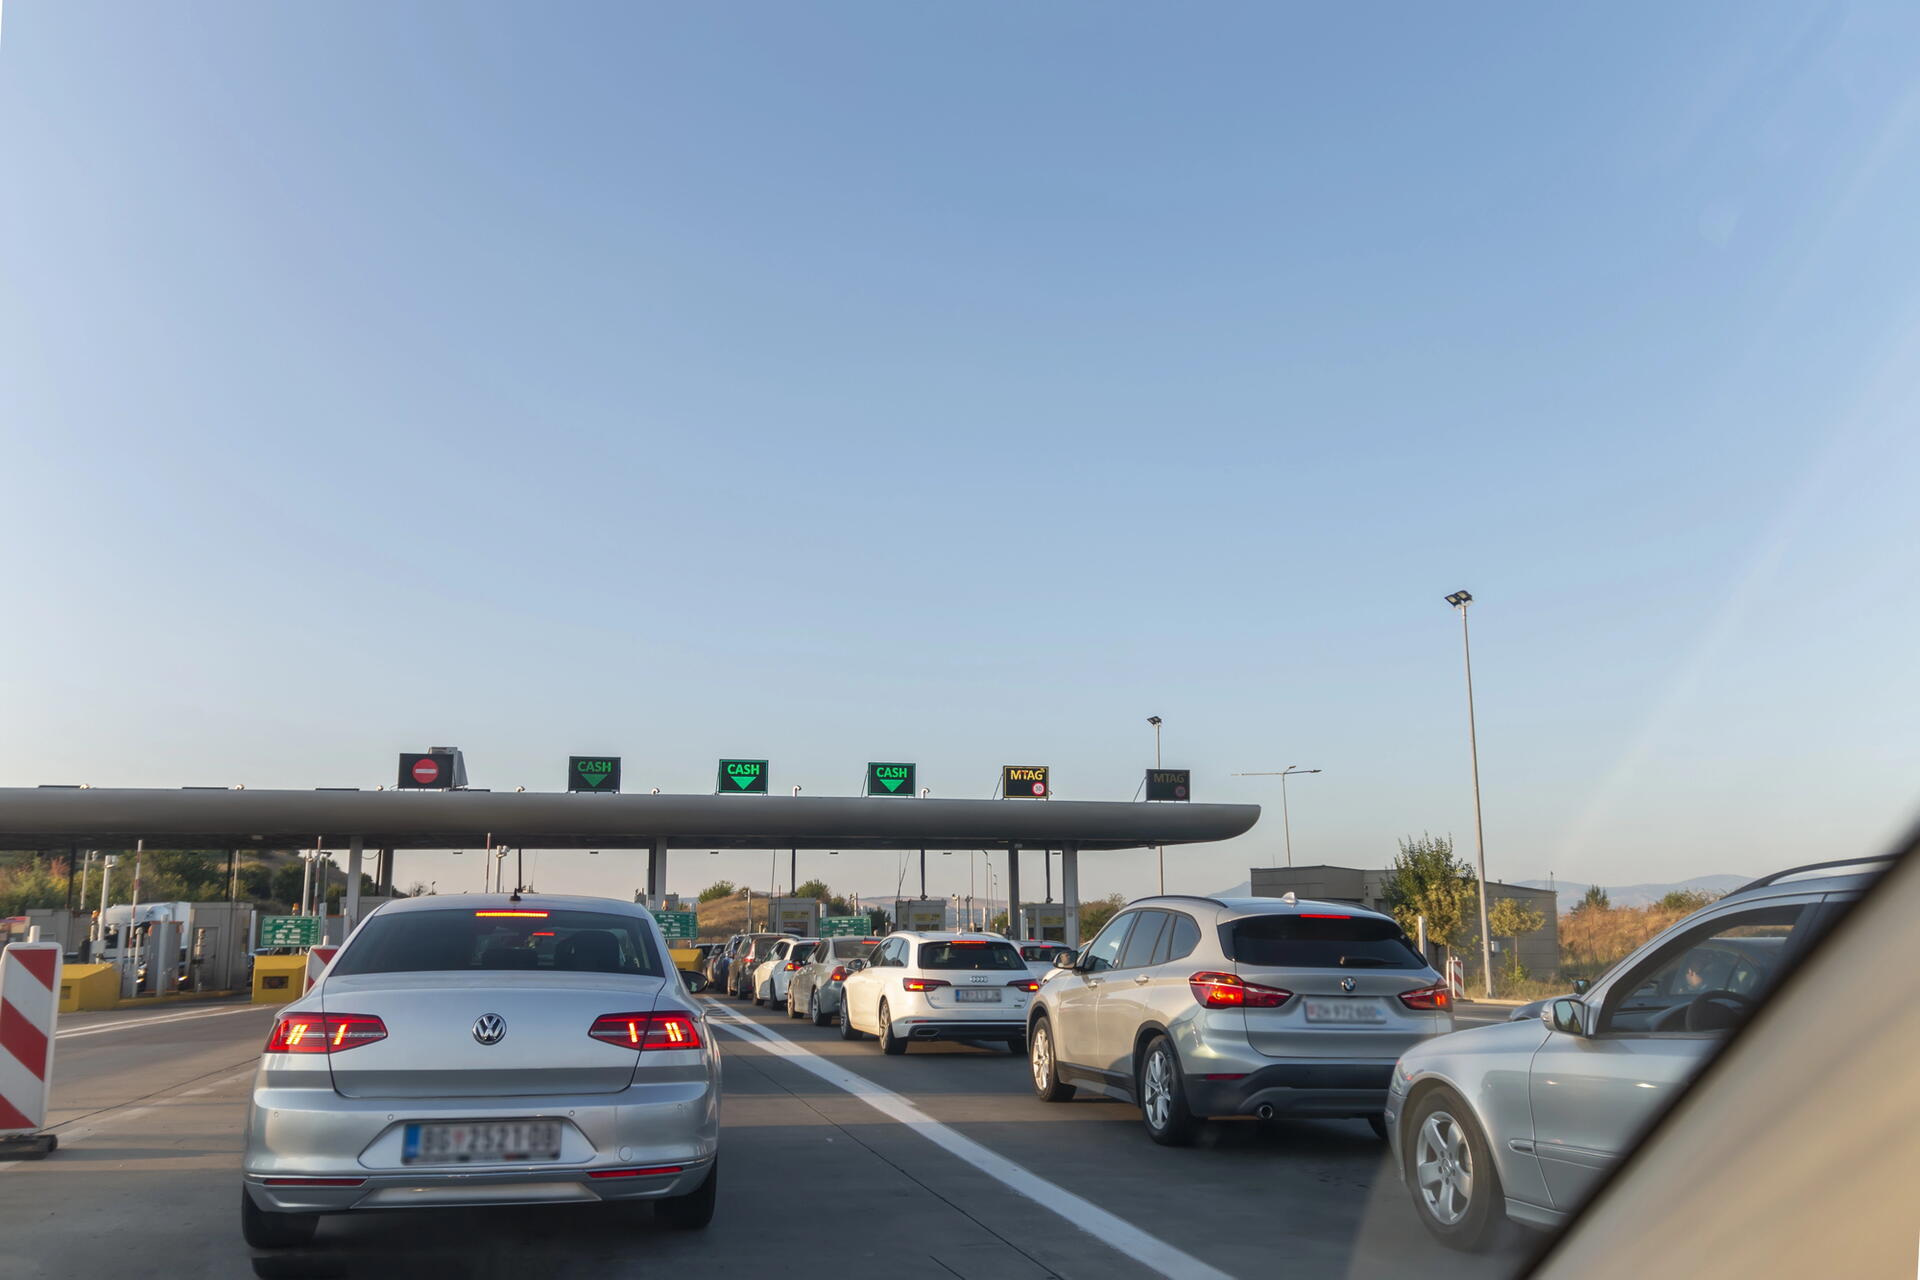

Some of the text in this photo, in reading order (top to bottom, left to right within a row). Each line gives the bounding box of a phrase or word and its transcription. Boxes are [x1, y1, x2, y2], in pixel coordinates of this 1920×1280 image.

[577, 761, 612, 773] CASH
[727, 764, 760, 775] CASH
[876, 767, 908, 778] CASH
[1010, 769, 1043, 781] MTAG
